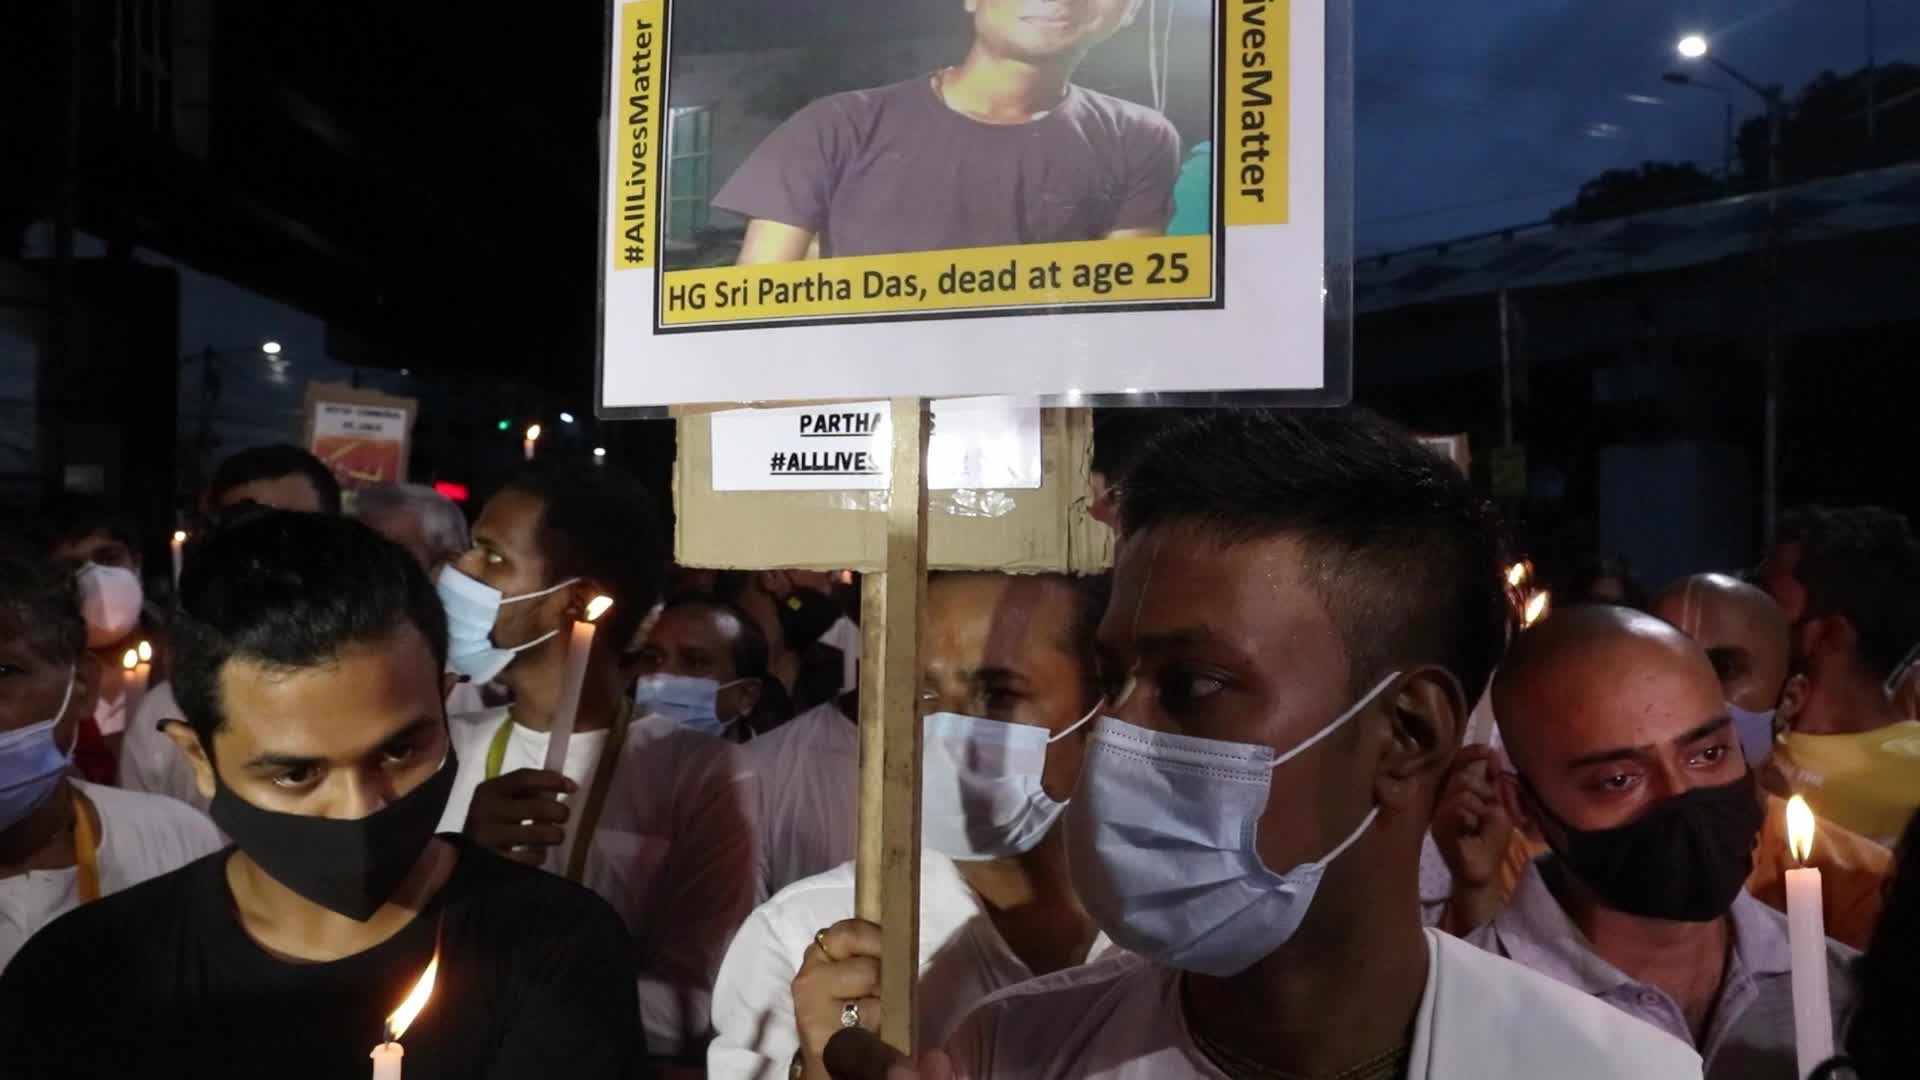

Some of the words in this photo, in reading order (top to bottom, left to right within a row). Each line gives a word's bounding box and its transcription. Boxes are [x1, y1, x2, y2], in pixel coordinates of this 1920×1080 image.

[624, 19, 653, 264] #AllLivesMatter
[668, 282, 706, 311] HG
[714, 278, 749, 308] Sri
[758, 272, 851, 304] Partha
[863, 270, 927, 302] Das,
[938, 260, 1017, 295] dead
[1028, 261, 1062, 289] at
[1072, 261, 1134, 294] age
[1146, 252, 1189, 285] 25
